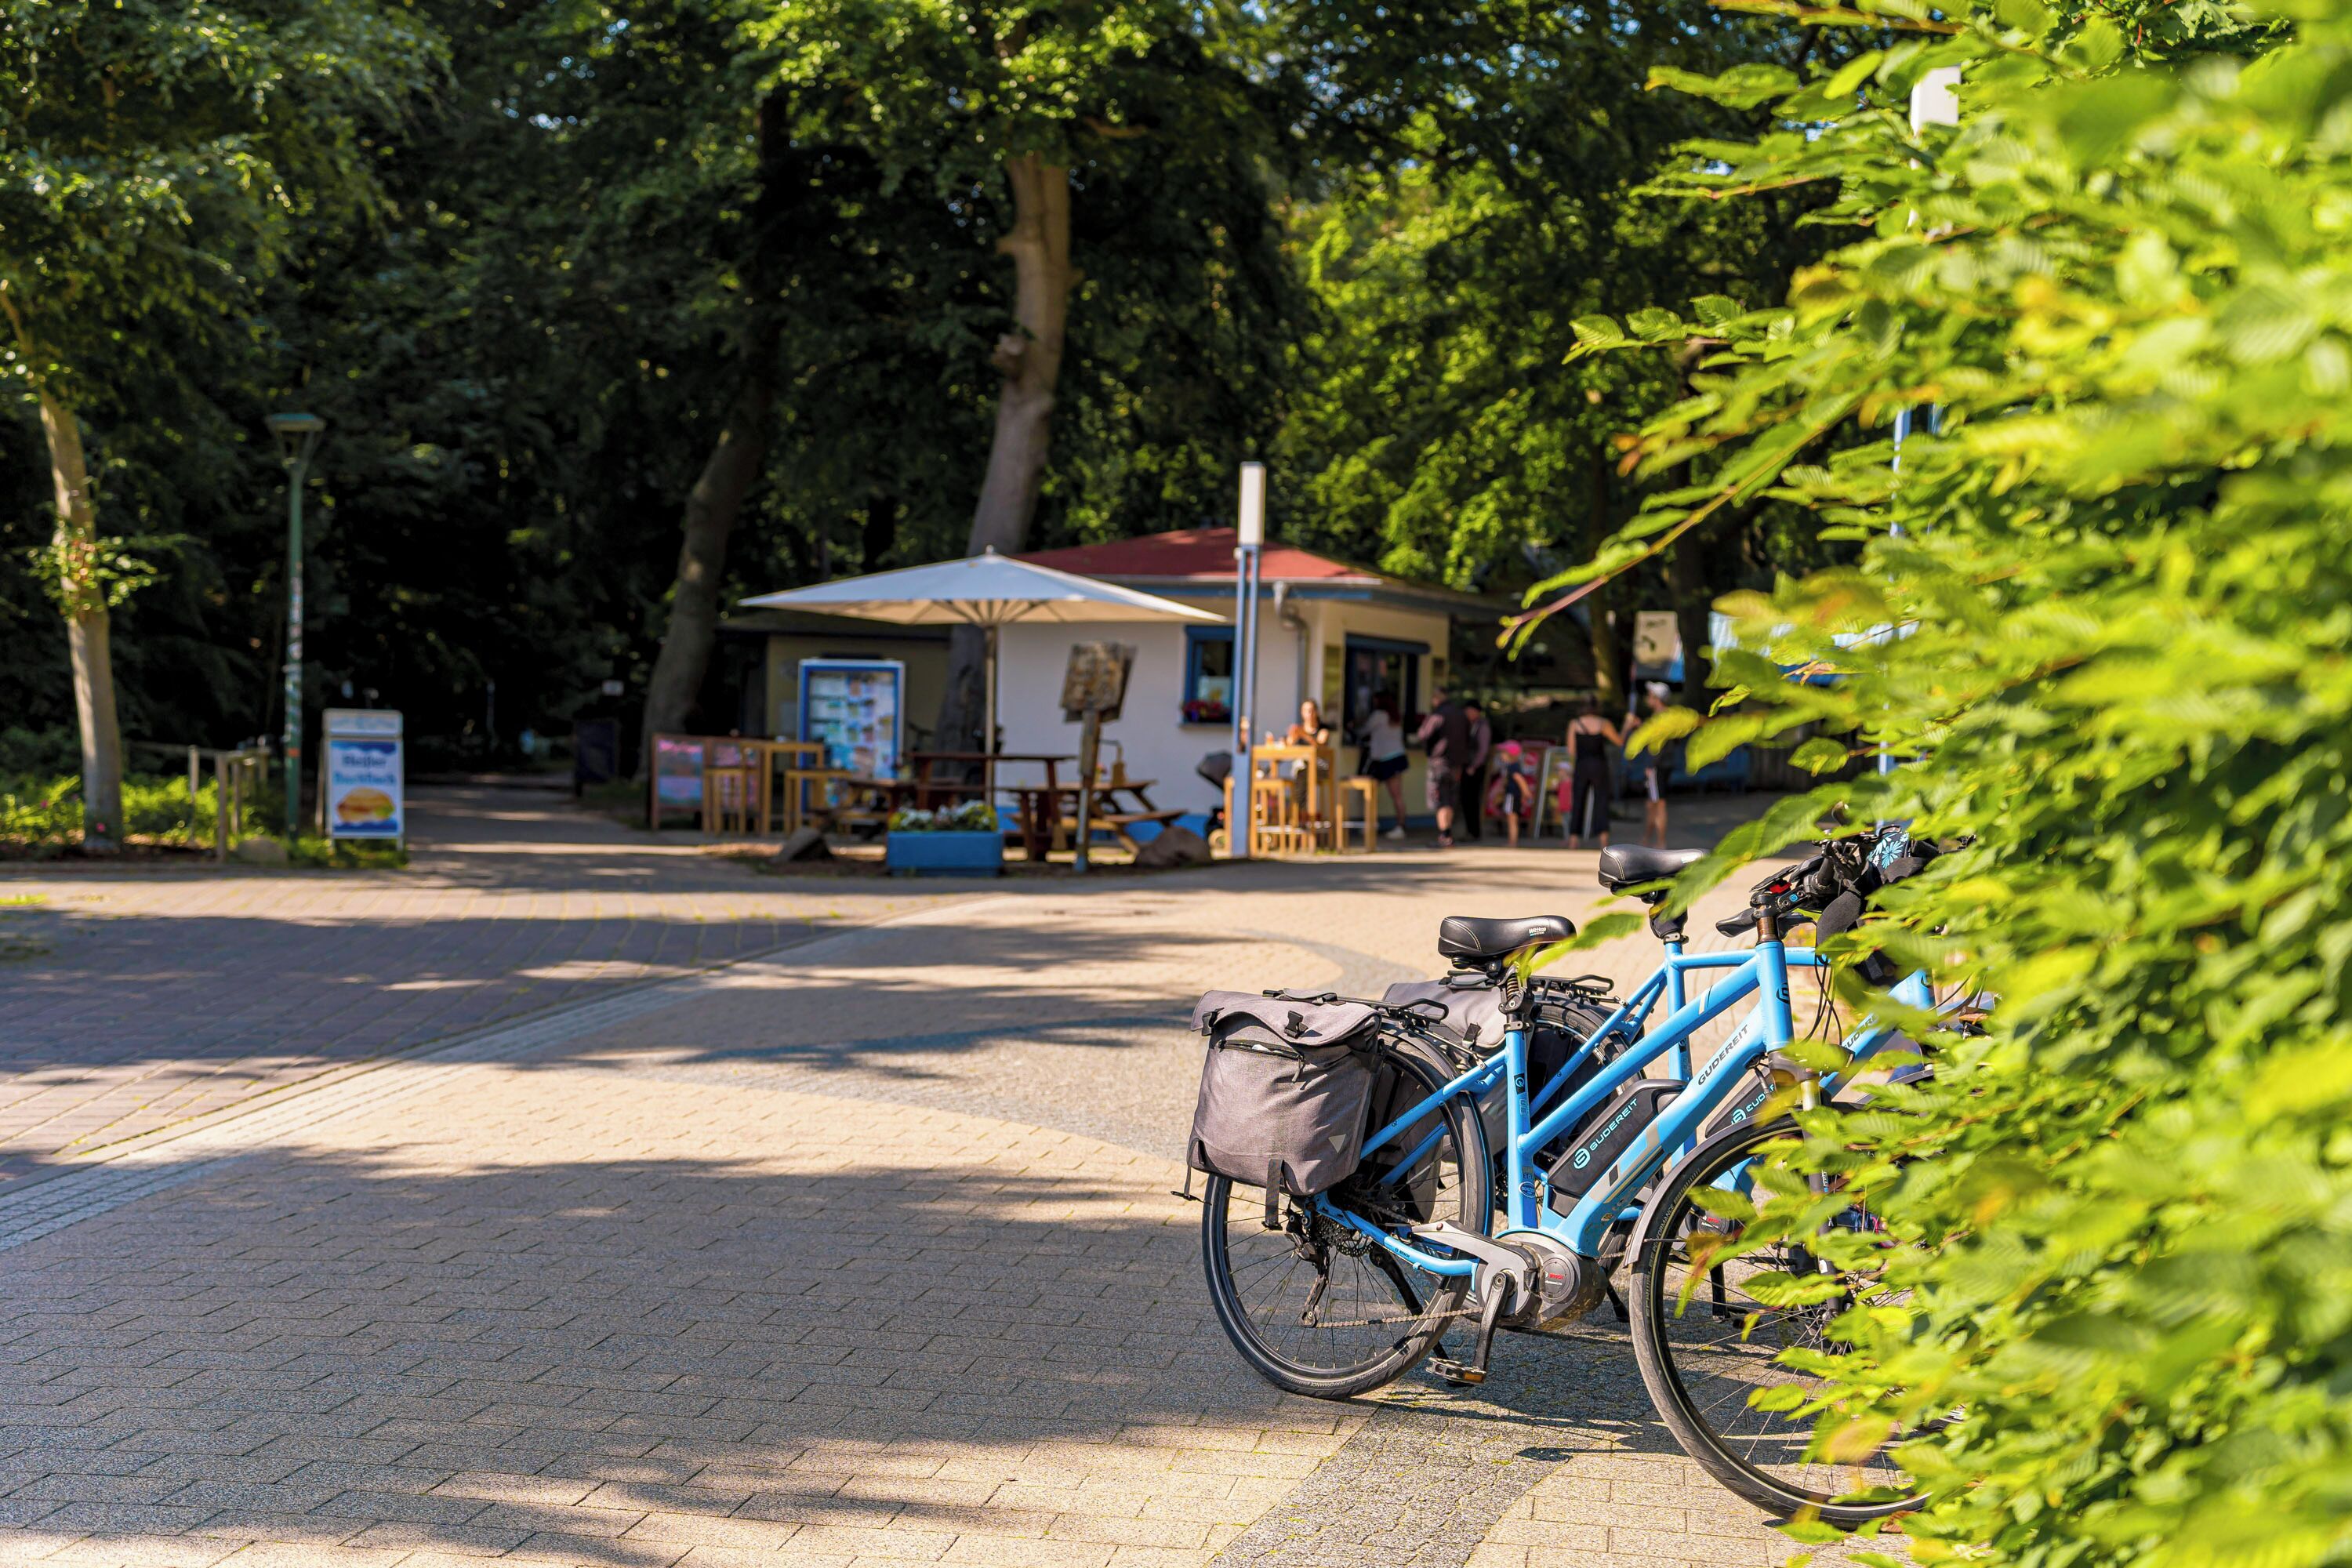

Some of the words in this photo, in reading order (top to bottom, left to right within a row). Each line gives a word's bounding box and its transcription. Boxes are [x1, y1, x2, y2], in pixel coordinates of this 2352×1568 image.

[1698, 1024, 1748, 1085] GUDEREIT
[1589, 1098, 1637, 1151] GUDEREIT
[1652, 1203, 1675, 1253] PEFORMANCE
